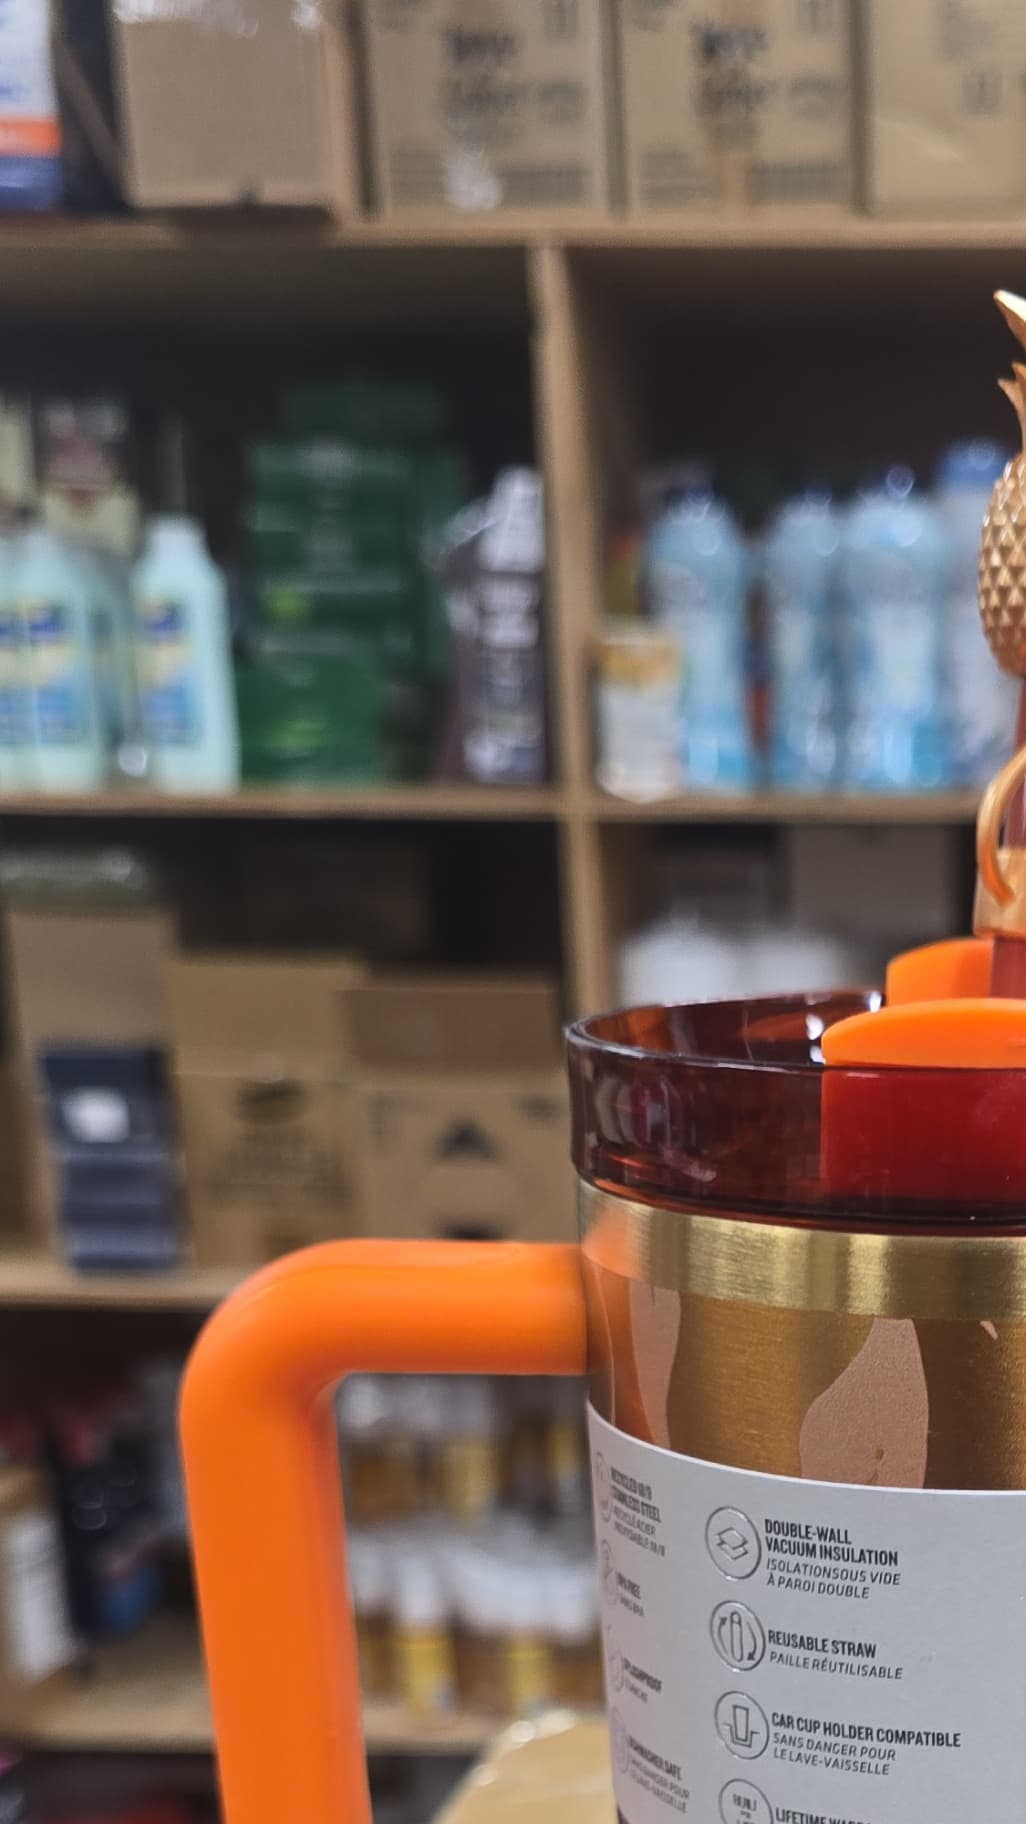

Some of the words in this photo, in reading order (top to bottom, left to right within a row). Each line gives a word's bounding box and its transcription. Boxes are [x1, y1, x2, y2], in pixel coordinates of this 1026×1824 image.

[764, 1519, 852, 1545] DOUBLE-WALL
[765, 1536, 817, 1558] VACUUM
[818, 1544, 898, 1567] INSULATION
[778, 1575, 815, 1593] PAROI
[817, 1582, 870, 1599] DOUBLE
[870, 1571, 901, 1586] VIDE
[768, 1629, 829, 1653] REUSABLE
[831, 1640, 877, 1659] STRAW
[770, 1651, 810, 1670] PAILLE
[812, 1657, 904, 1680] RÉUTILISABLE
[771, 1712, 795, 1730] CAR
[796, 1717, 821, 1734] CUP
[823, 1721, 874, 1741] HOLDER
[876, 1727, 961, 1748] COMPATIBLE
[773, 1732, 804, 1749] SANS
[859, 1746, 897, 1761] POUR
[773, 1747, 787, 1760] LE
[789, 1750, 890, 1776] LAVE-VAISSELLE
